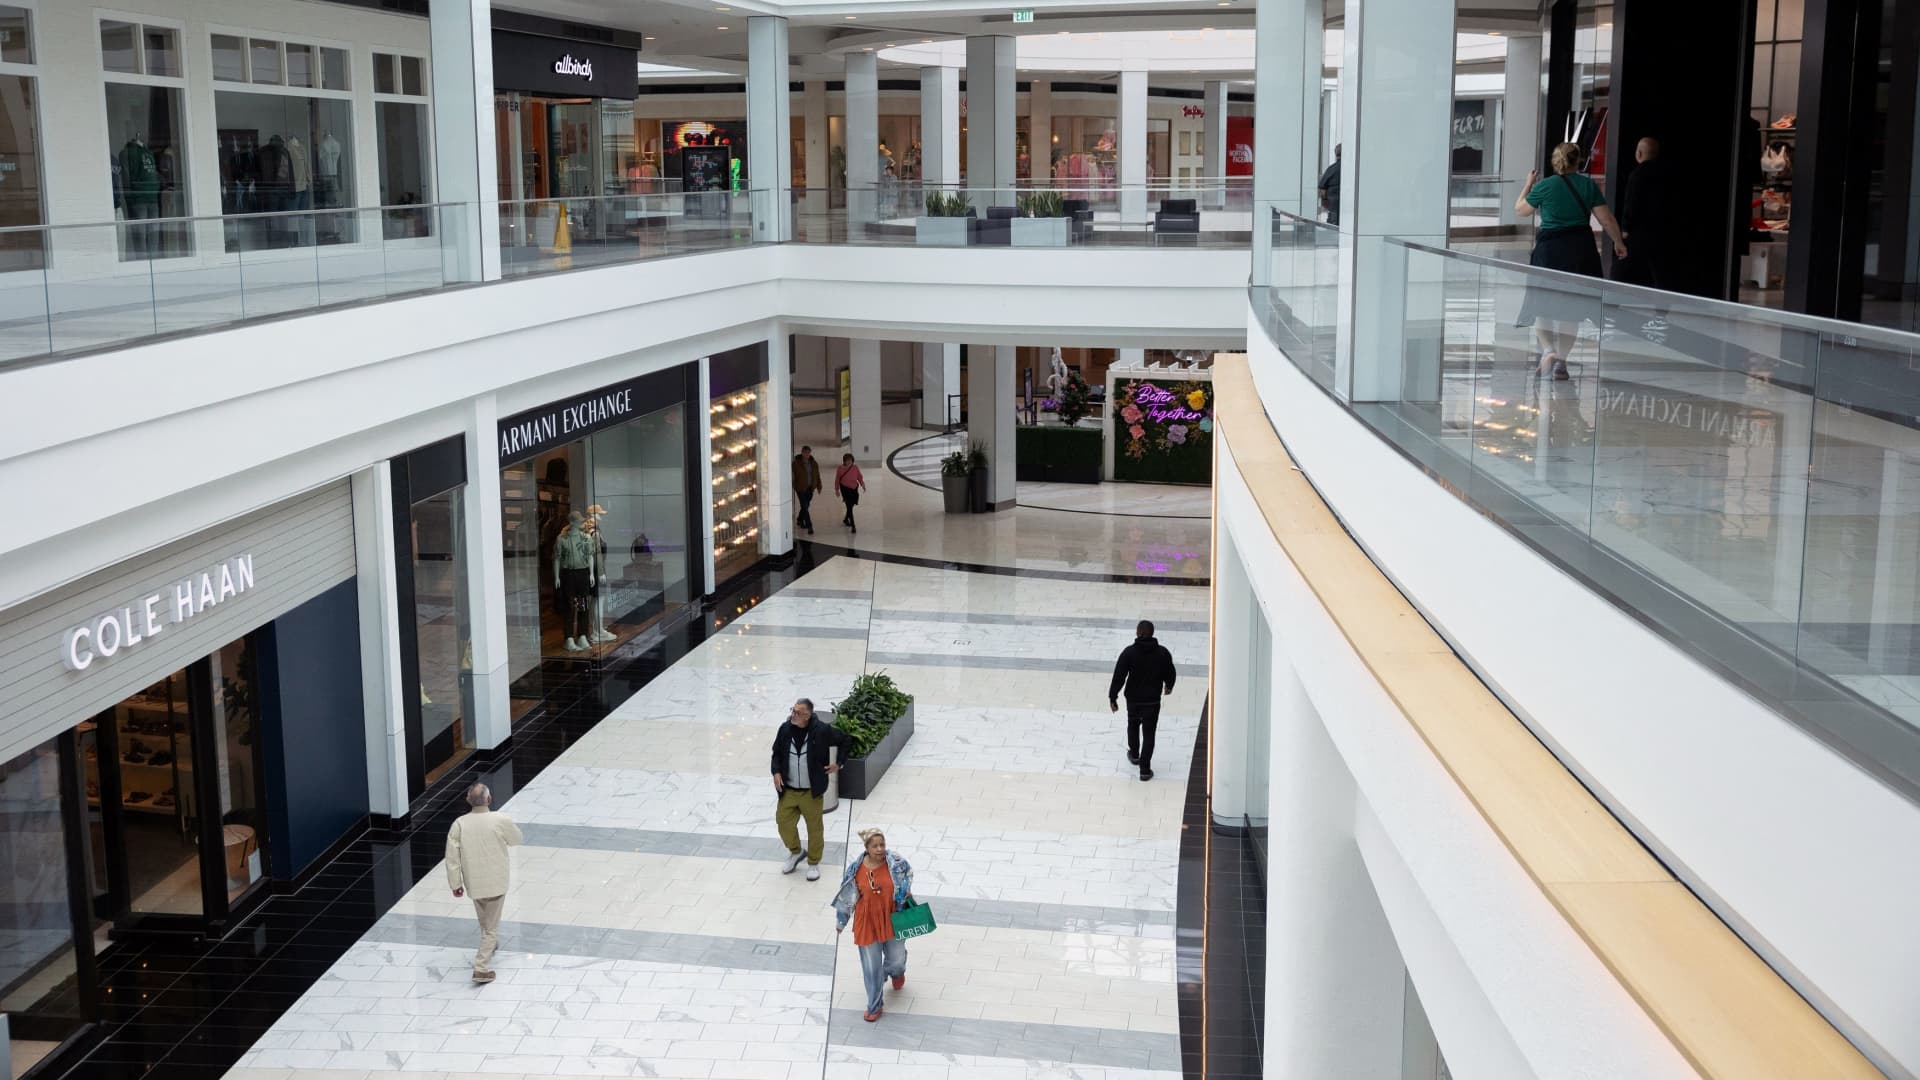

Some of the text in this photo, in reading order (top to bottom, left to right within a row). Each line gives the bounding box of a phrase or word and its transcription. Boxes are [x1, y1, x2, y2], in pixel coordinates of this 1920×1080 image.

[555, 54, 593, 82] allbirds
[1136, 386, 1176, 404] Better
[501, 389, 633, 457] ARMANI EXCHANGE
[1147, 403, 1202, 424] Together
[68, 553, 255, 671] COLE HAAN
